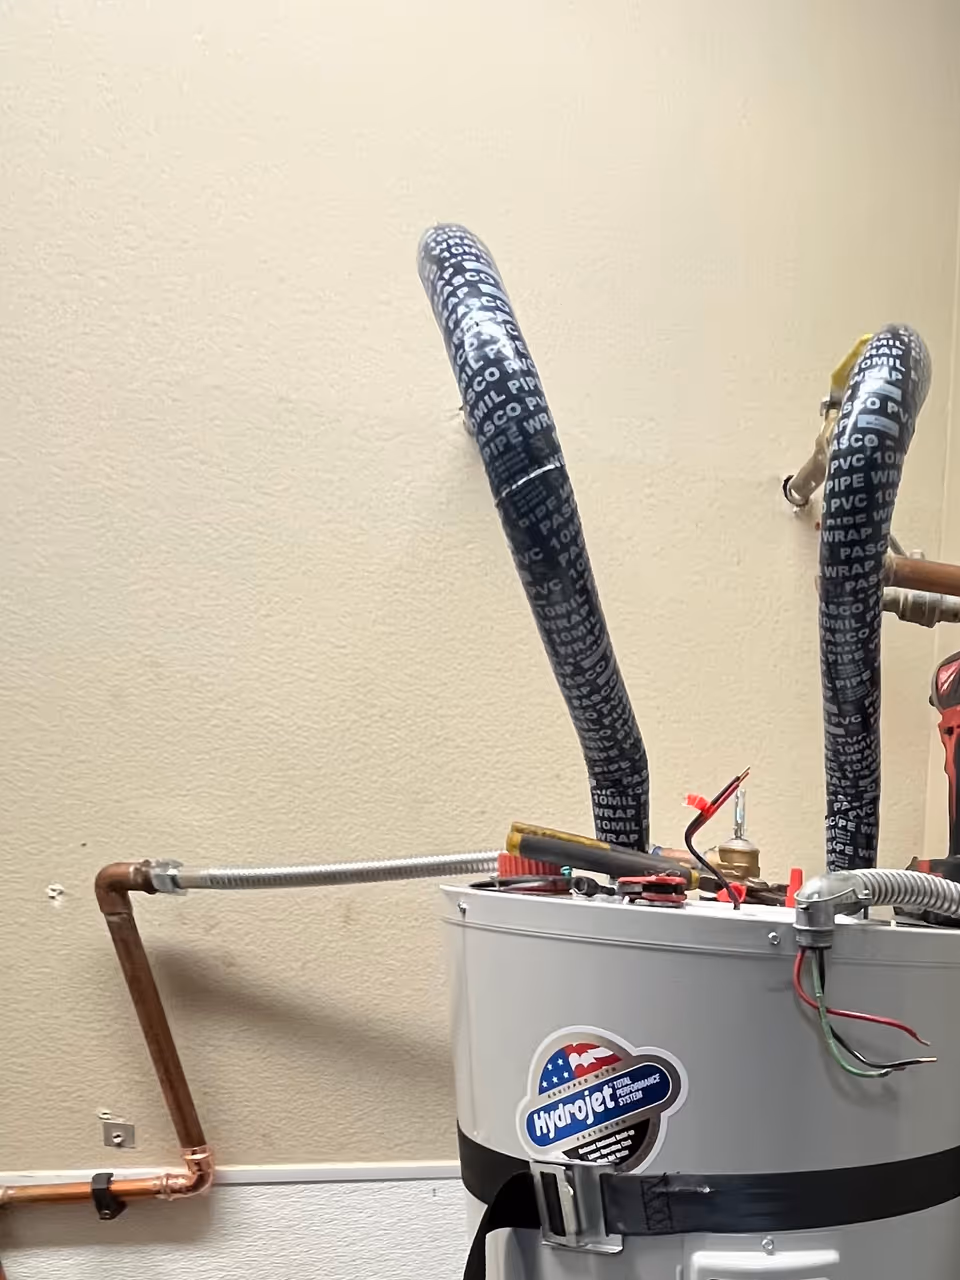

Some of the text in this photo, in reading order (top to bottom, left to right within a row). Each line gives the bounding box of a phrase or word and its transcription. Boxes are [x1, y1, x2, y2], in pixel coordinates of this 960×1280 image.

[482, 426, 523, 463] PIPE
[830, 453, 865, 475] PVC
[826, 473, 865, 494] PIPE
[830, 493, 867, 513] PVC
[822, 527, 873, 543] WRAP
[824, 560, 875, 578] WRAP
[826, 650, 865, 664] PIPE
[835, 670, 872, 689] PIPE
[831, 714, 862, 725] PVC
[593, 794, 637, 807] 10MIL
[593, 805, 636, 819] WRAP
[848, 804, 875, 820] PVC
[595, 819, 640, 832] 10MIL
[595, 830, 639, 844] WRAP
[547, 1066, 618, 1099] EQUIPPED WITH
[613, 1076, 633, 1089] TOTAL
[616, 1073, 661, 1098] PERFORMANCE
[618, 1090, 644, 1107] SYSTEM
[533, 1083, 615, 1140] Hydrojet
[576, 1118, 627, 1142] FEATURING
